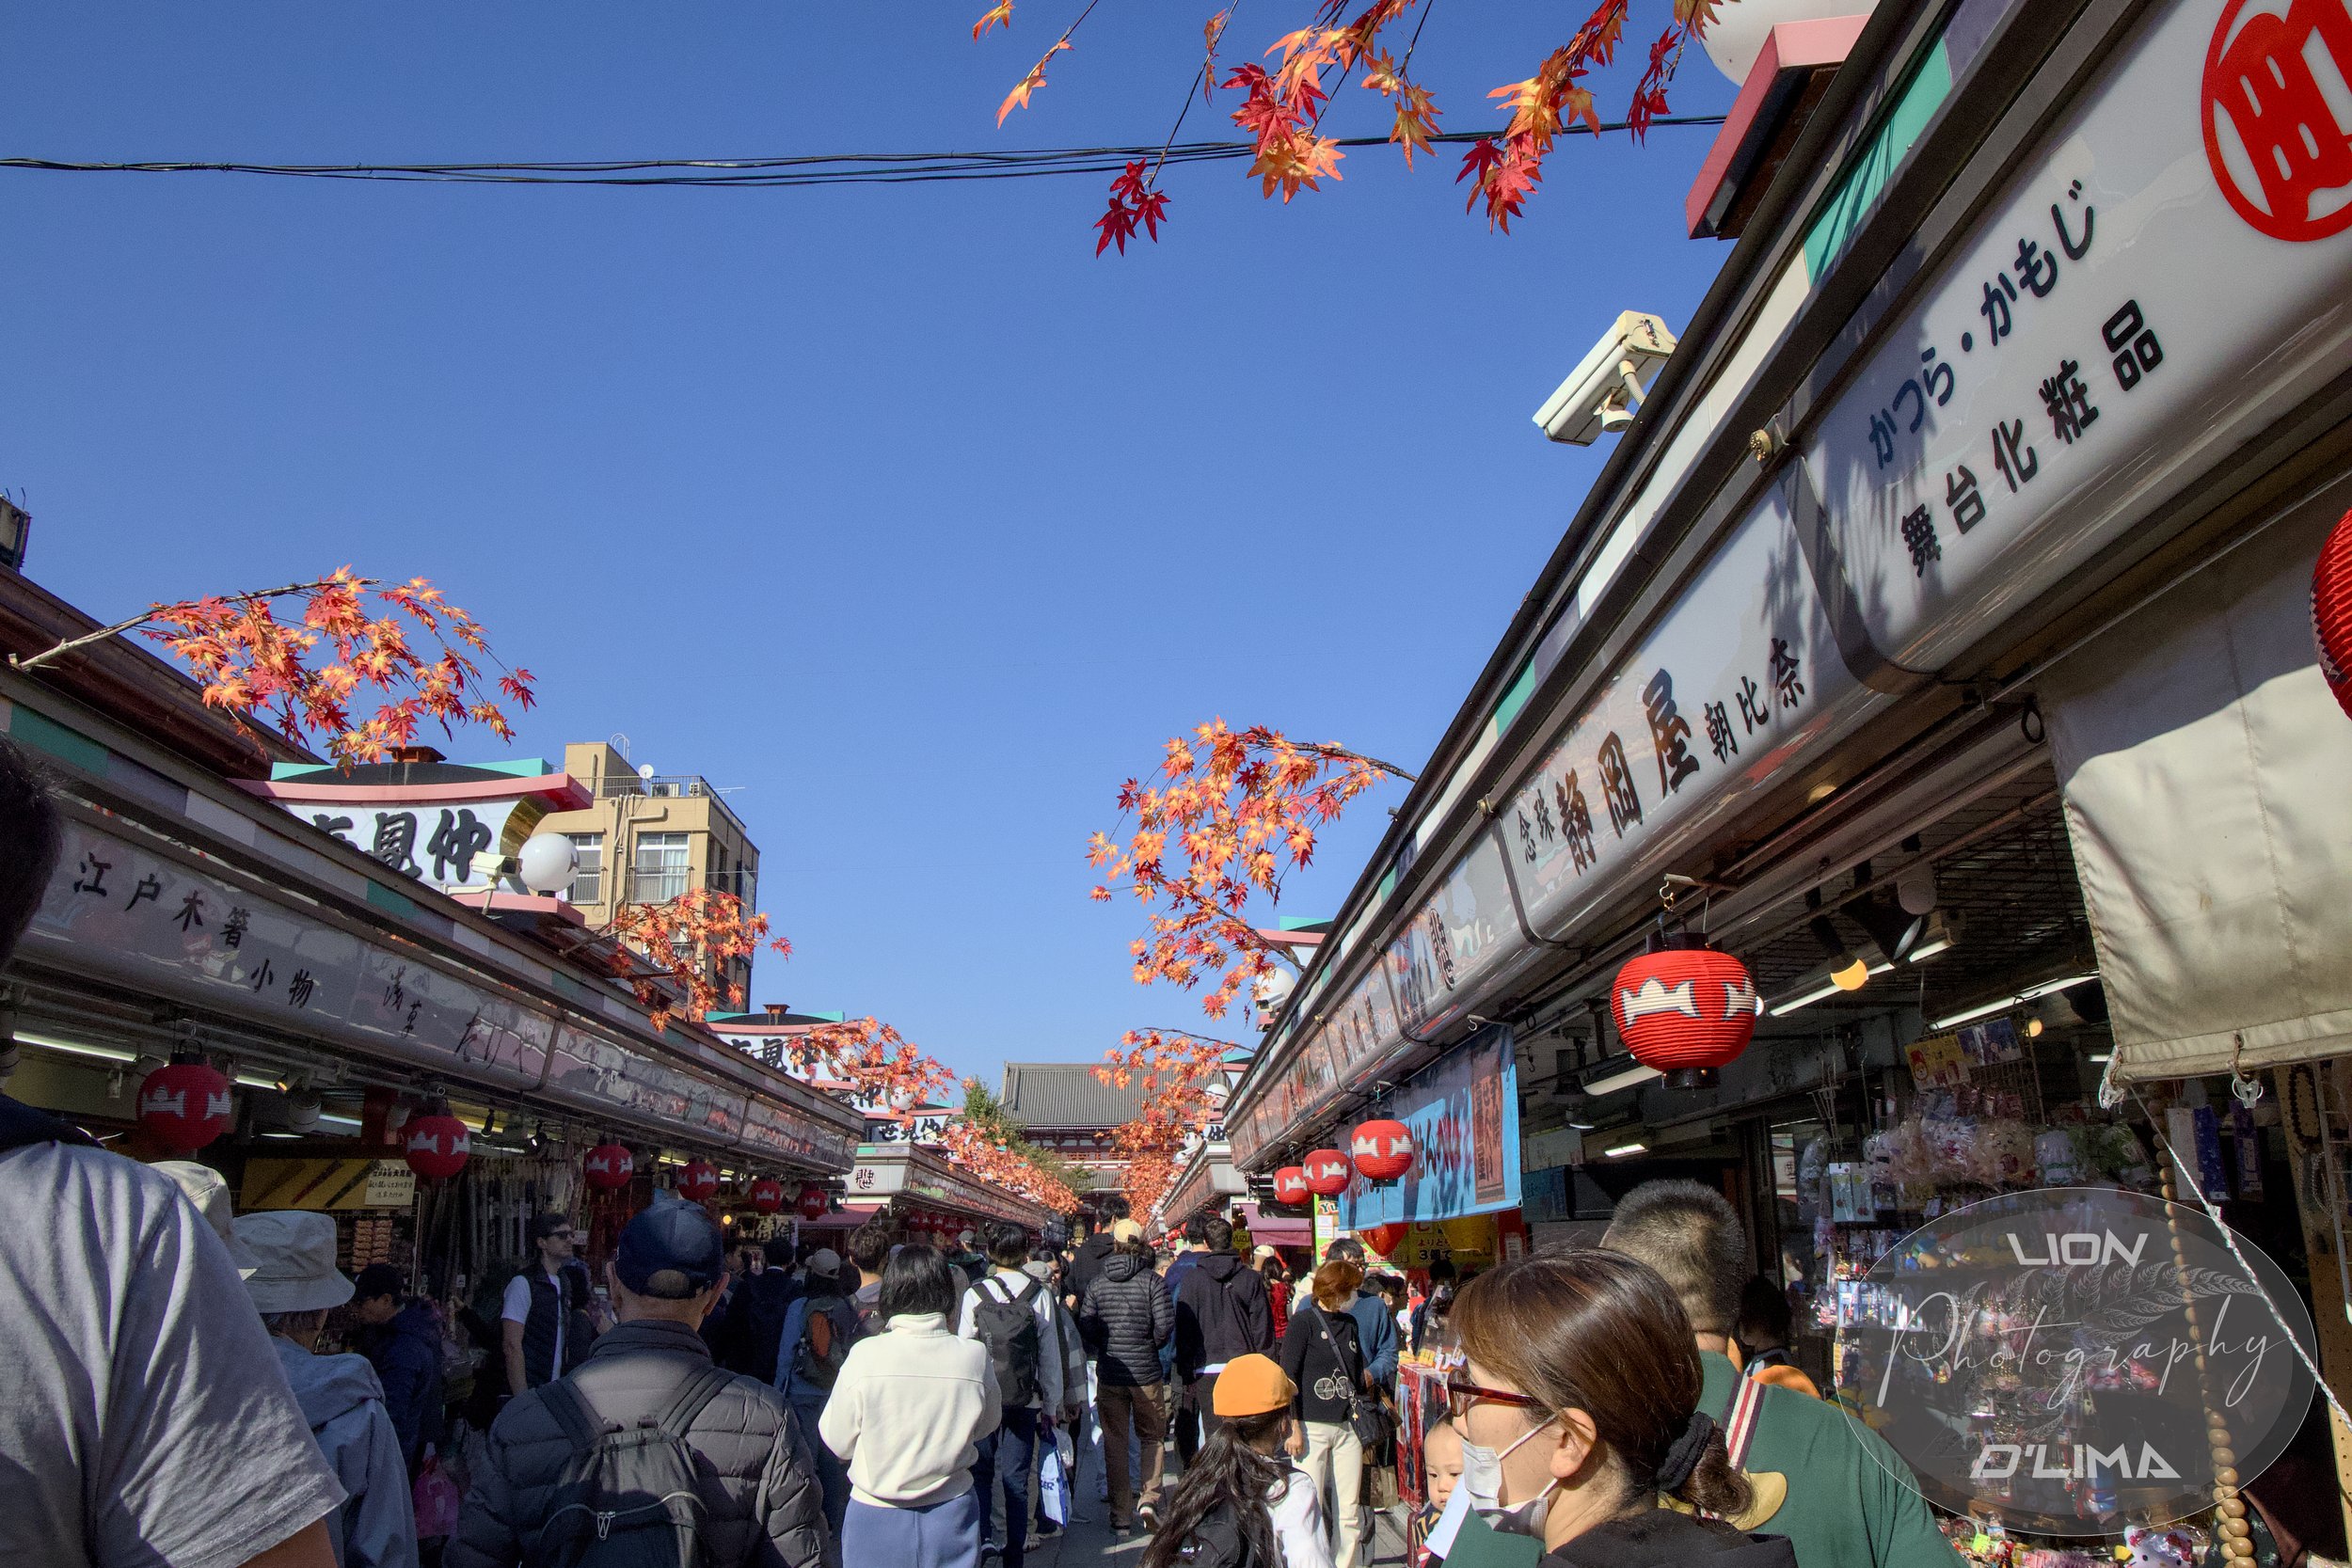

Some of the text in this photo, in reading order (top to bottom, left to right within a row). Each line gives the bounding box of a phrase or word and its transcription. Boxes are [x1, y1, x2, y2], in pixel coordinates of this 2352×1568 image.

[1868, 179, 2094, 469] かつら・かもじ
[1901, 298, 2163, 578] 舞台化粧品
[1704, 637, 1805, 765] 朝比奈
[73, 851, 249, 949] 江戸木箸
[250, 958, 315, 1008] 小物
